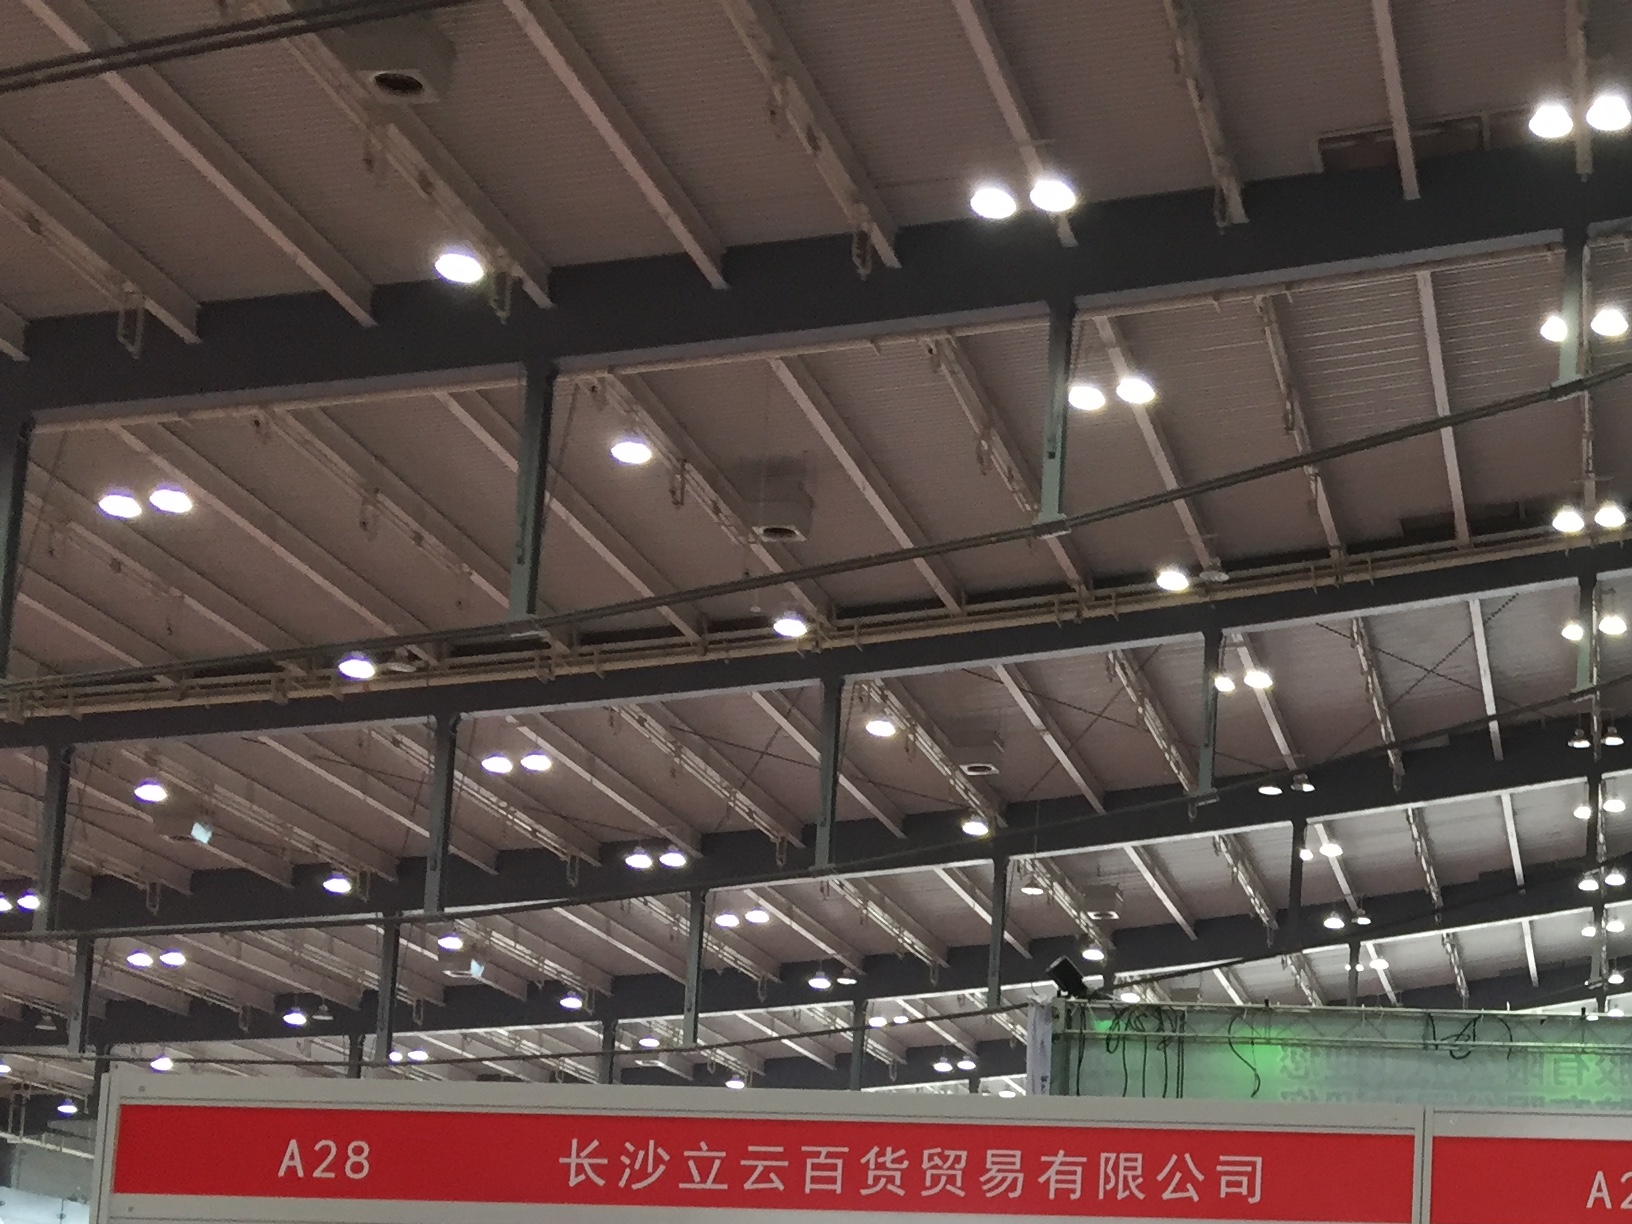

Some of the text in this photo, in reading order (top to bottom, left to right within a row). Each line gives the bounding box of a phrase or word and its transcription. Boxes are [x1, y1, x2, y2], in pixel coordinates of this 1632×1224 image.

[278, 1139, 372, 1180] A28
[559, 1138, 1265, 1204] 长沙立云百货贸易有限公司
